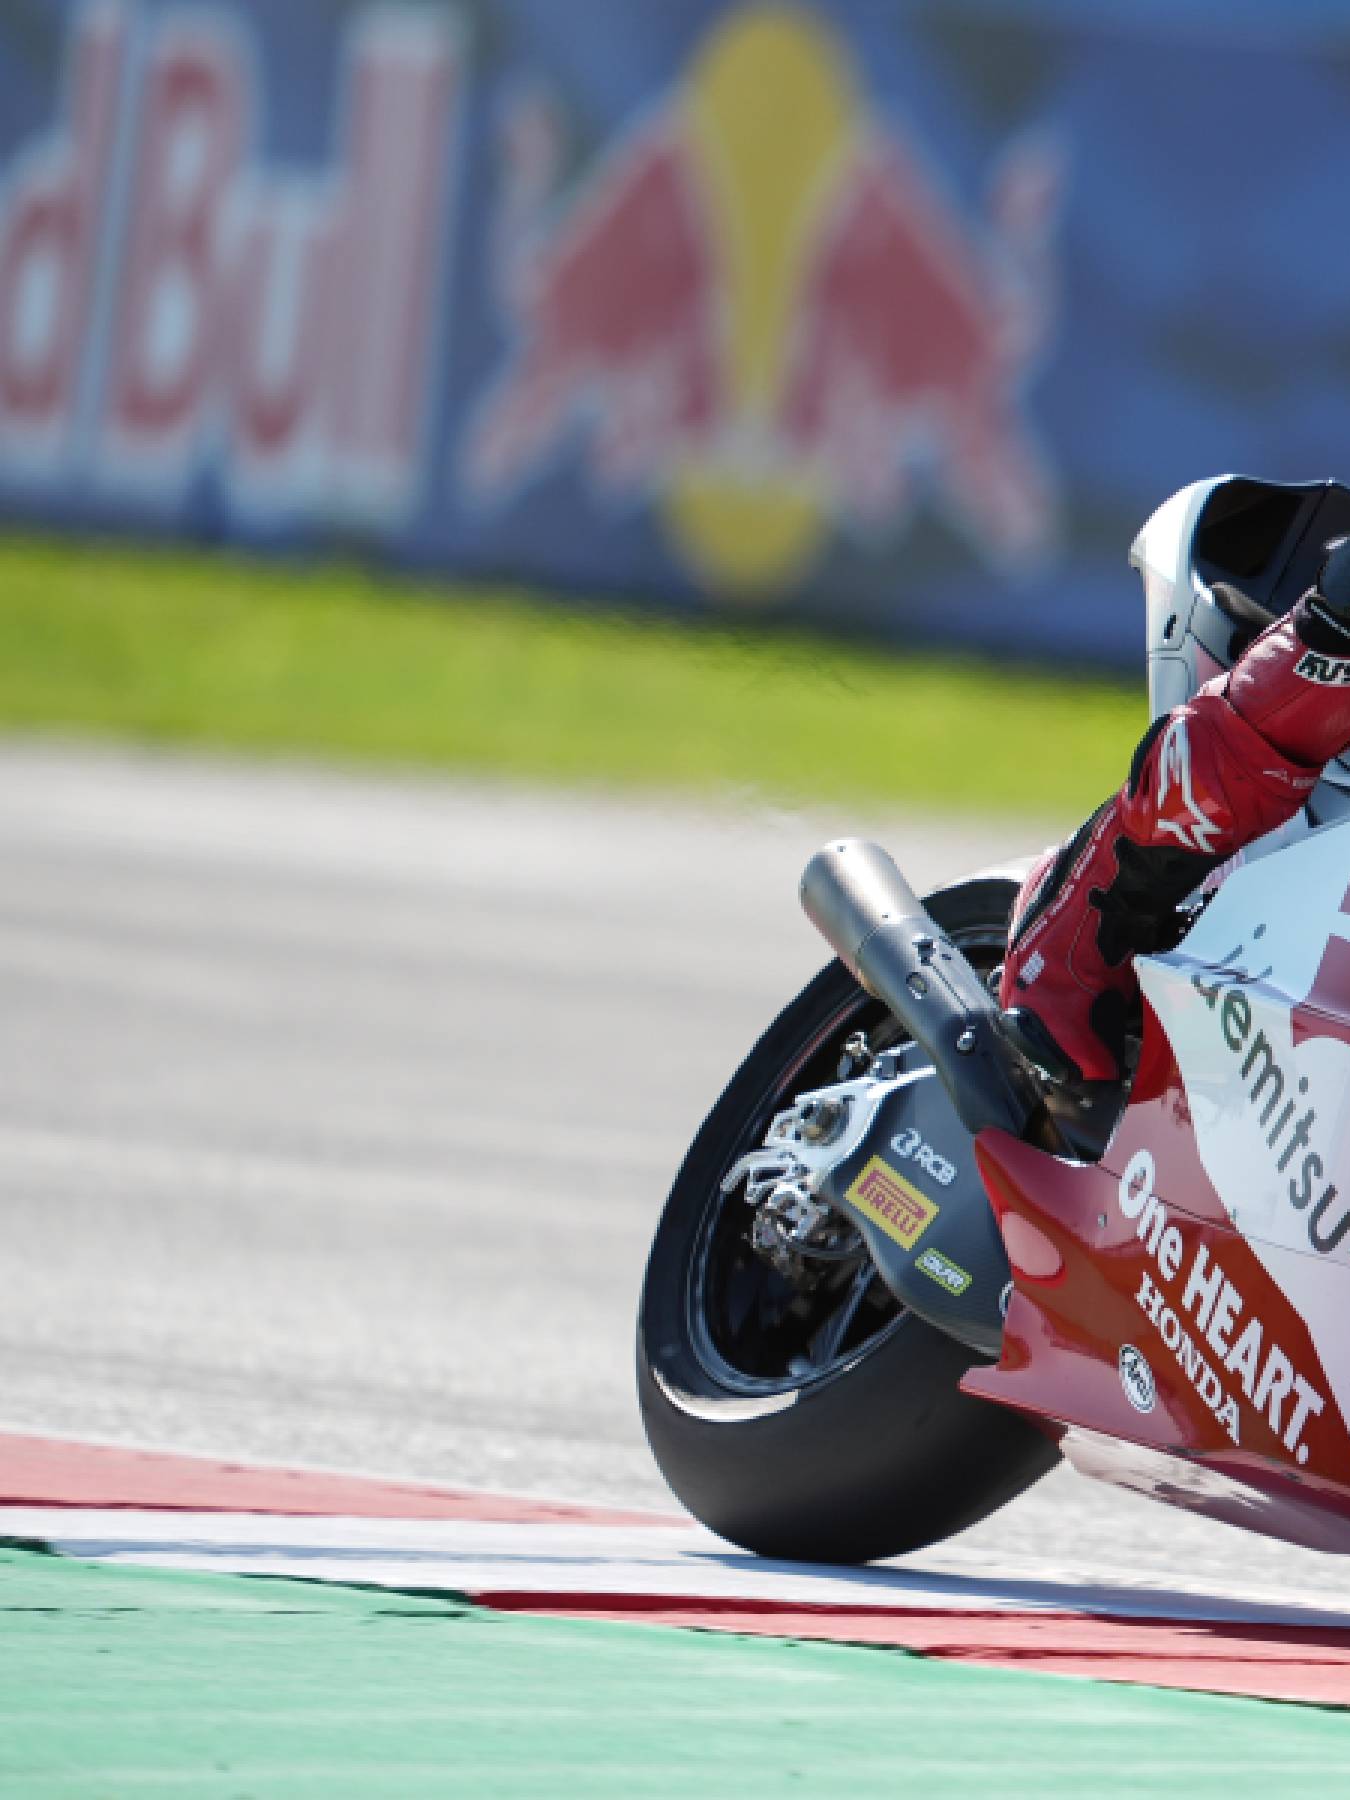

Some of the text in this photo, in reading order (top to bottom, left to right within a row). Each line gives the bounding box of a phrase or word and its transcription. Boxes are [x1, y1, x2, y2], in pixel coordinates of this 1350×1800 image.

[857, 1169, 928, 1237] PIRELLI
[1118, 1149, 1325, 1465] One HEART.
[1134, 1272, 1241, 1447] HONDA
